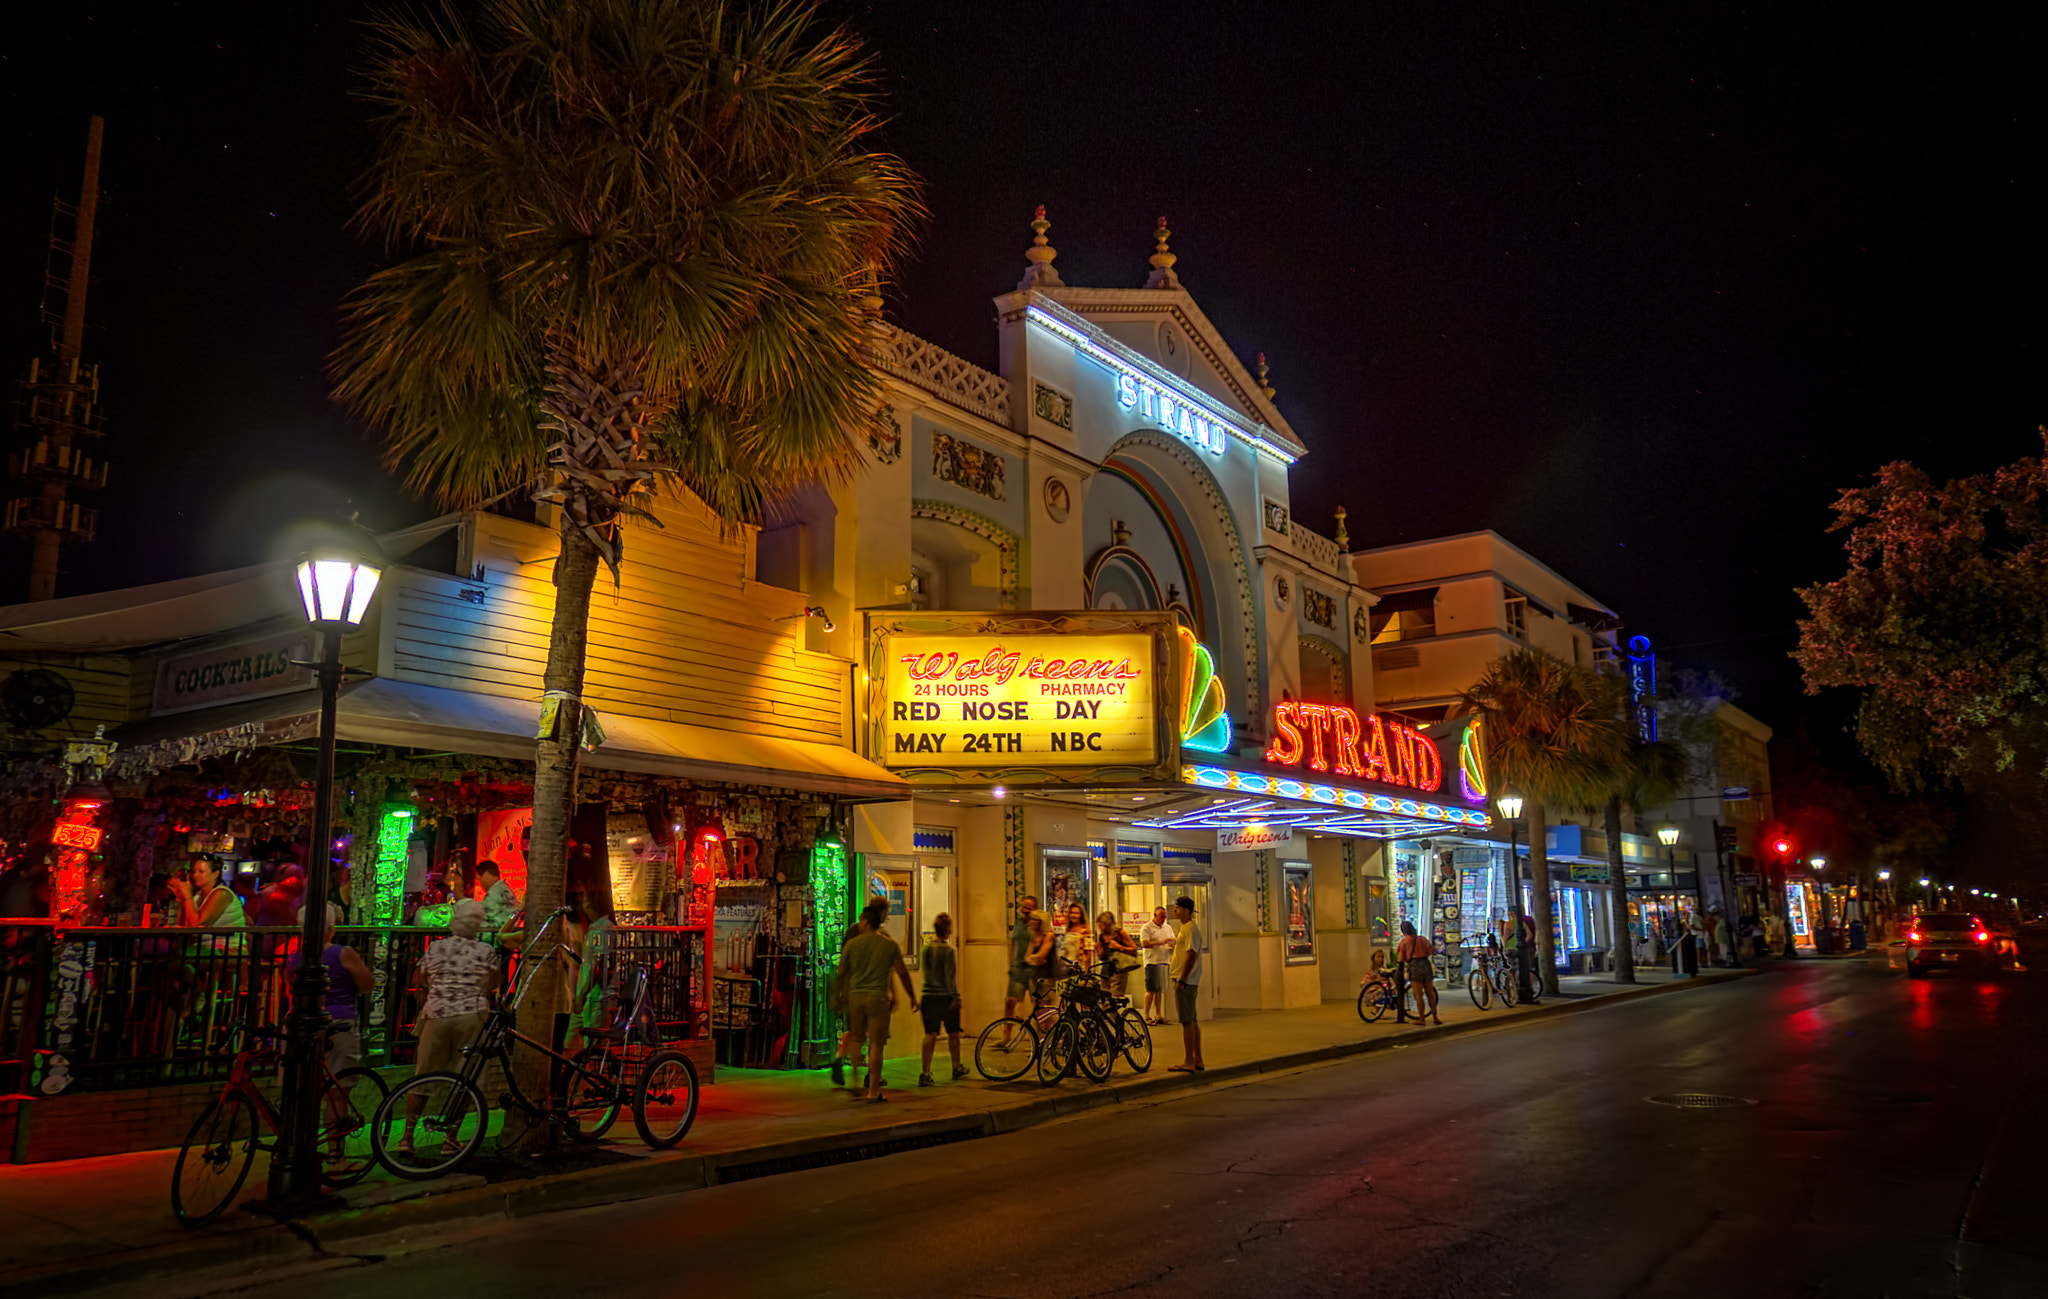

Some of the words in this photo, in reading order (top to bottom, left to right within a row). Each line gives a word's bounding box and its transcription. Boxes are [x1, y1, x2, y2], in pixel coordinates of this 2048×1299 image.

[1118, 374, 1227, 455] STRAND
[174, 649, 289, 694] COCKTAILS
[914, 684, 931, 696] 24
[936, 684, 989, 696] HOURS
[1041, 683, 1126, 696] PHARMACY
[893, 701, 941, 721] RED
[962, 701, 1029, 721] NOSE
[1056, 700, 1102, 720] DAY
[895, 733, 947, 753] MAY
[963, 732, 1022, 752] 24TH
[1051, 732, 1103, 752] NBC
[1266, 701, 1442, 792] STRAND
[59, 825, 97, 849] 525
[1220, 829, 1291, 849] Walgreens
[727, 907, 756, 917] FEATURES
